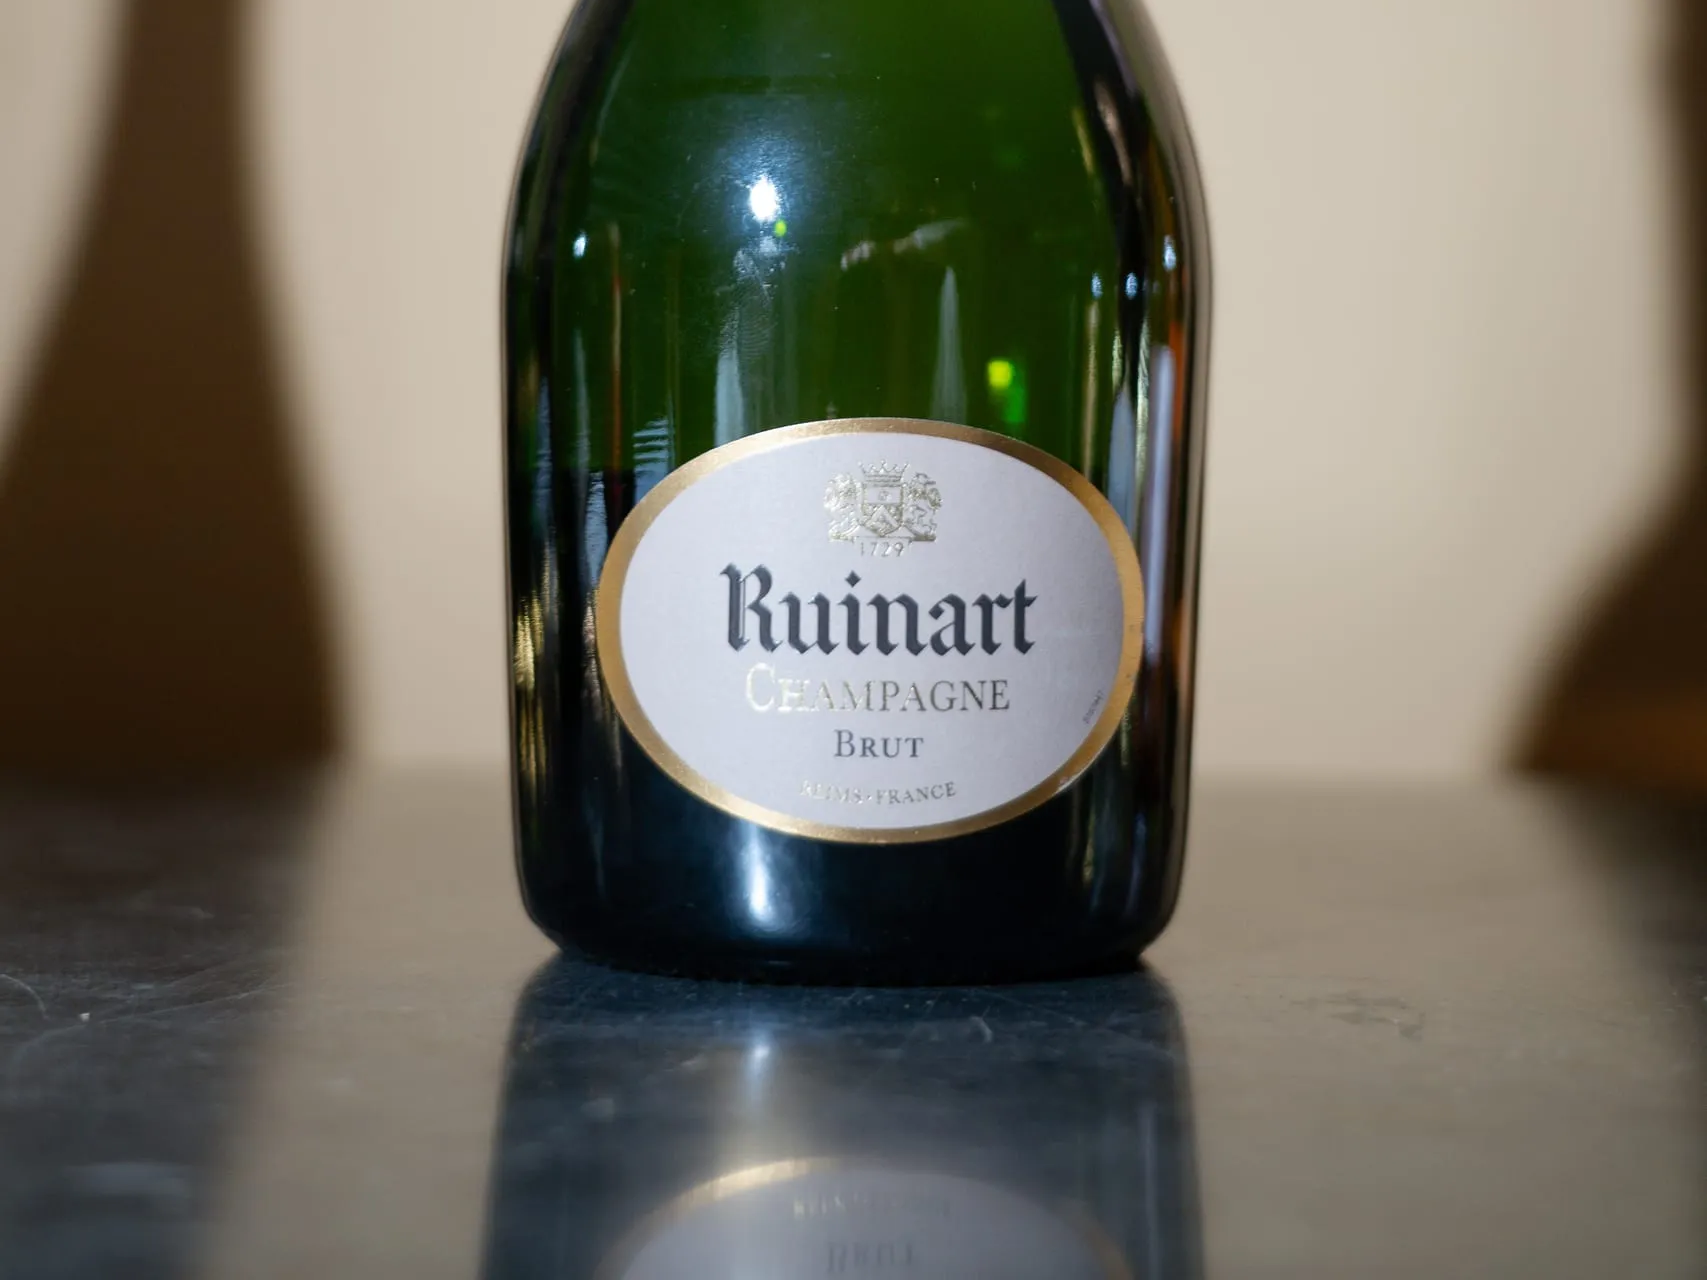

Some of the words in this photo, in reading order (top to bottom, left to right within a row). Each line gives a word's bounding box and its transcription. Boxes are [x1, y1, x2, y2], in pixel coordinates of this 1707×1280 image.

[859, 541, 905, 558] 1729
[720, 562, 1038, 656] Ruinart
[745, 662, 1010, 712] CHAMPAGNE
[833, 729, 924, 758] BRUT
